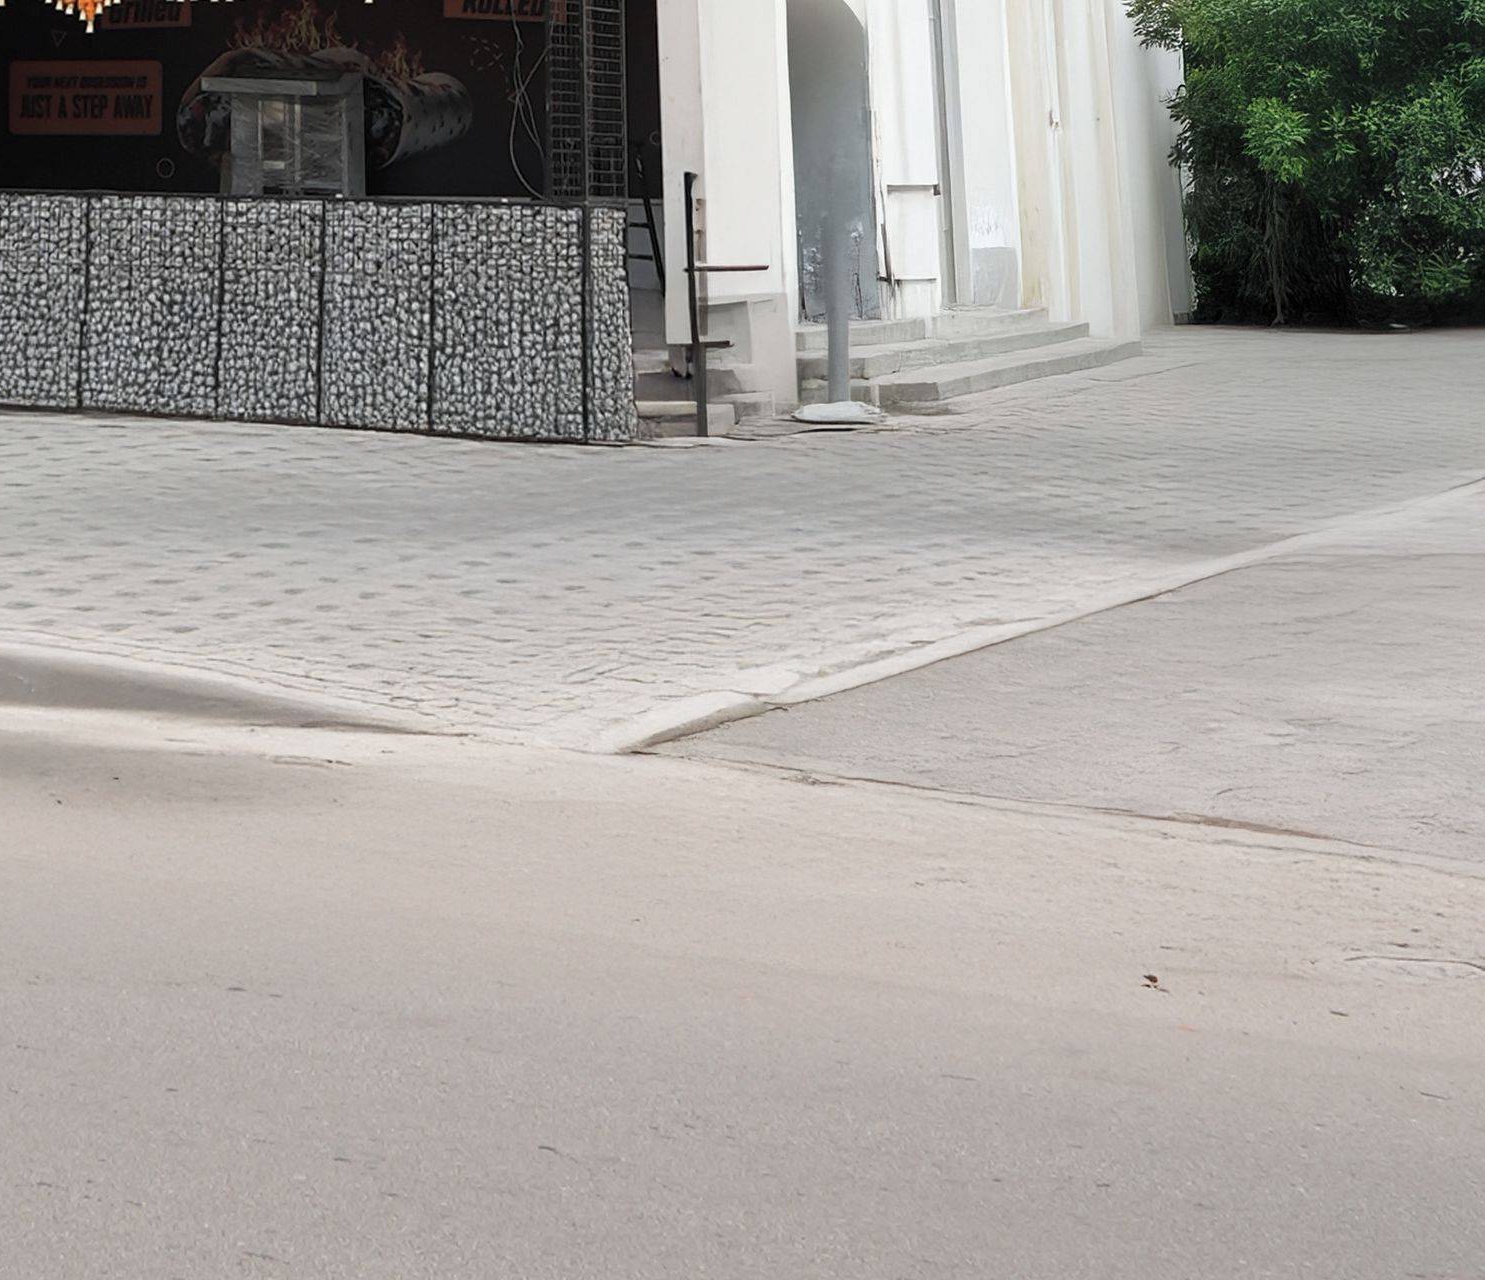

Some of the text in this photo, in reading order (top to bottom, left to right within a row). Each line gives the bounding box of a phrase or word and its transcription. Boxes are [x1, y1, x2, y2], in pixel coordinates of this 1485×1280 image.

[54, 76, 79, 89] NEXT
[19, 95, 153, 119] JUST A STEP AWAY
